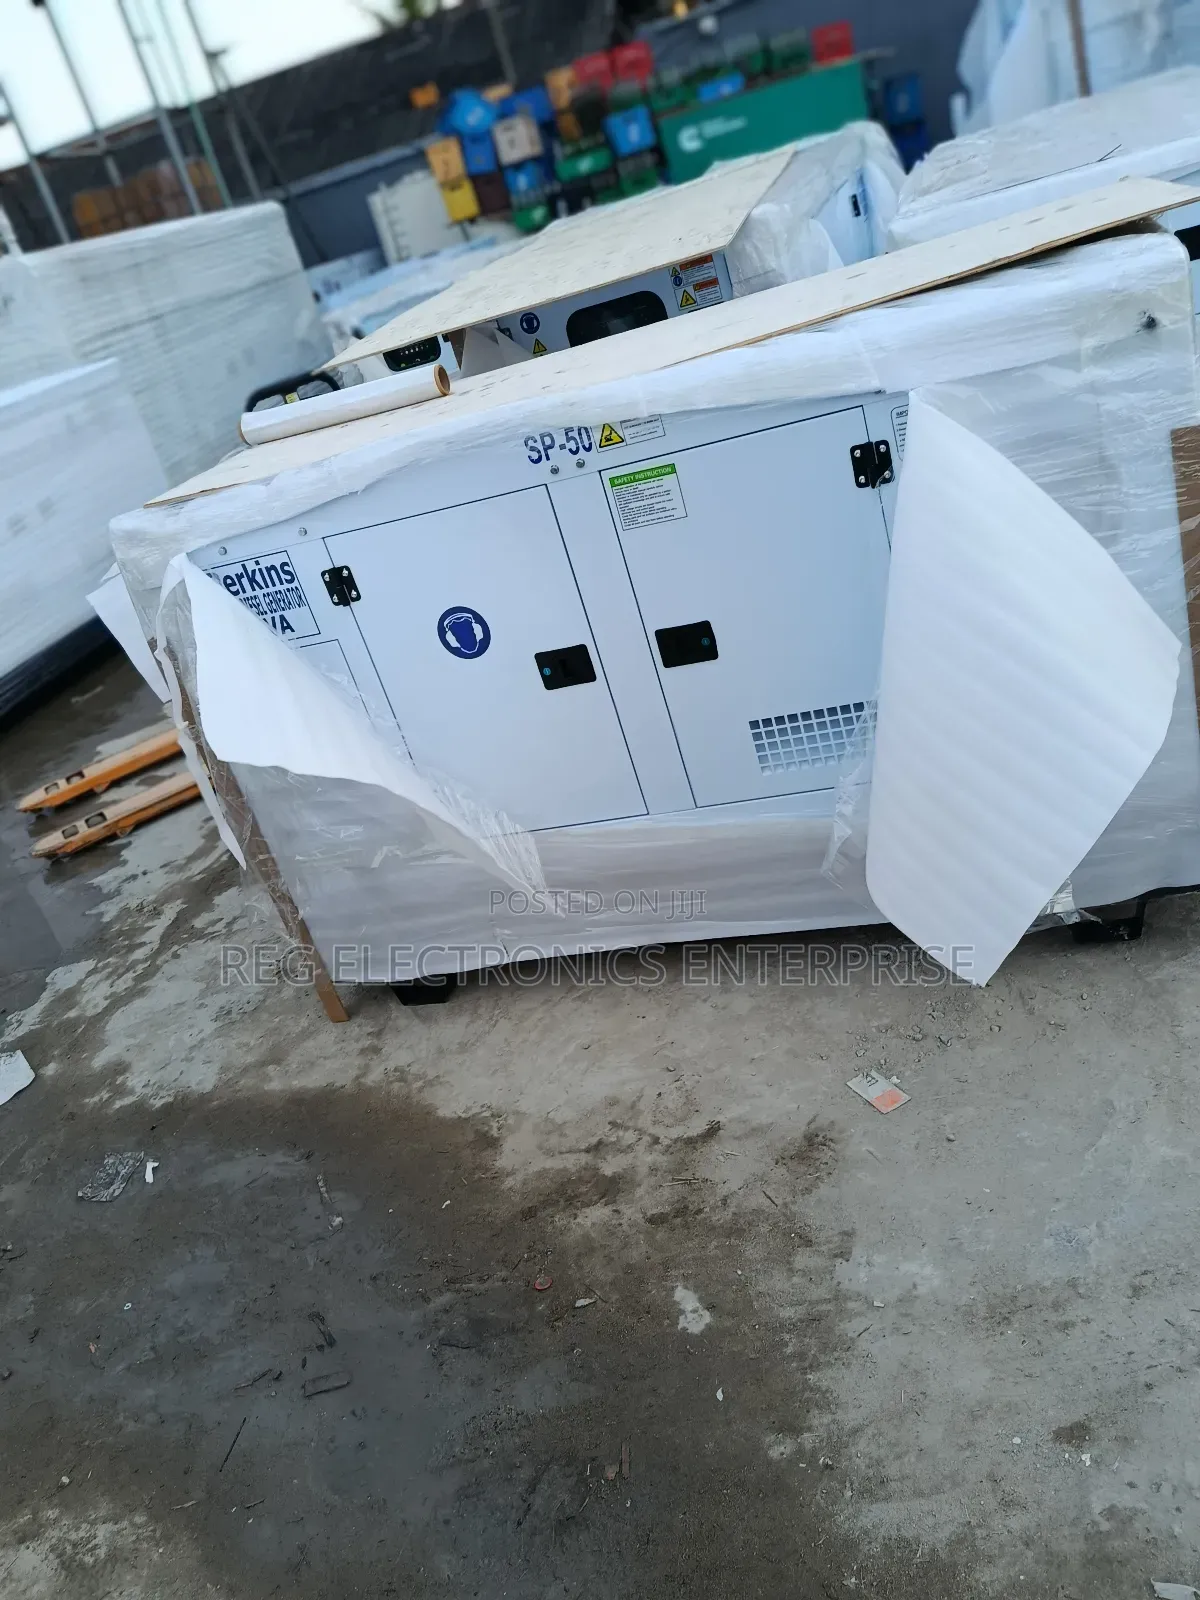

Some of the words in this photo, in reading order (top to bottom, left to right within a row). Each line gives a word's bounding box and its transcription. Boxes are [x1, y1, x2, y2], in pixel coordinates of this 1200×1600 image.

[523, 425, 593, 464] SP-50
[614, 474, 634, 485] SAFETY
[634, 466, 672, 481] INSTRUCTION
[262, 586, 307, 614] GENERATOR
